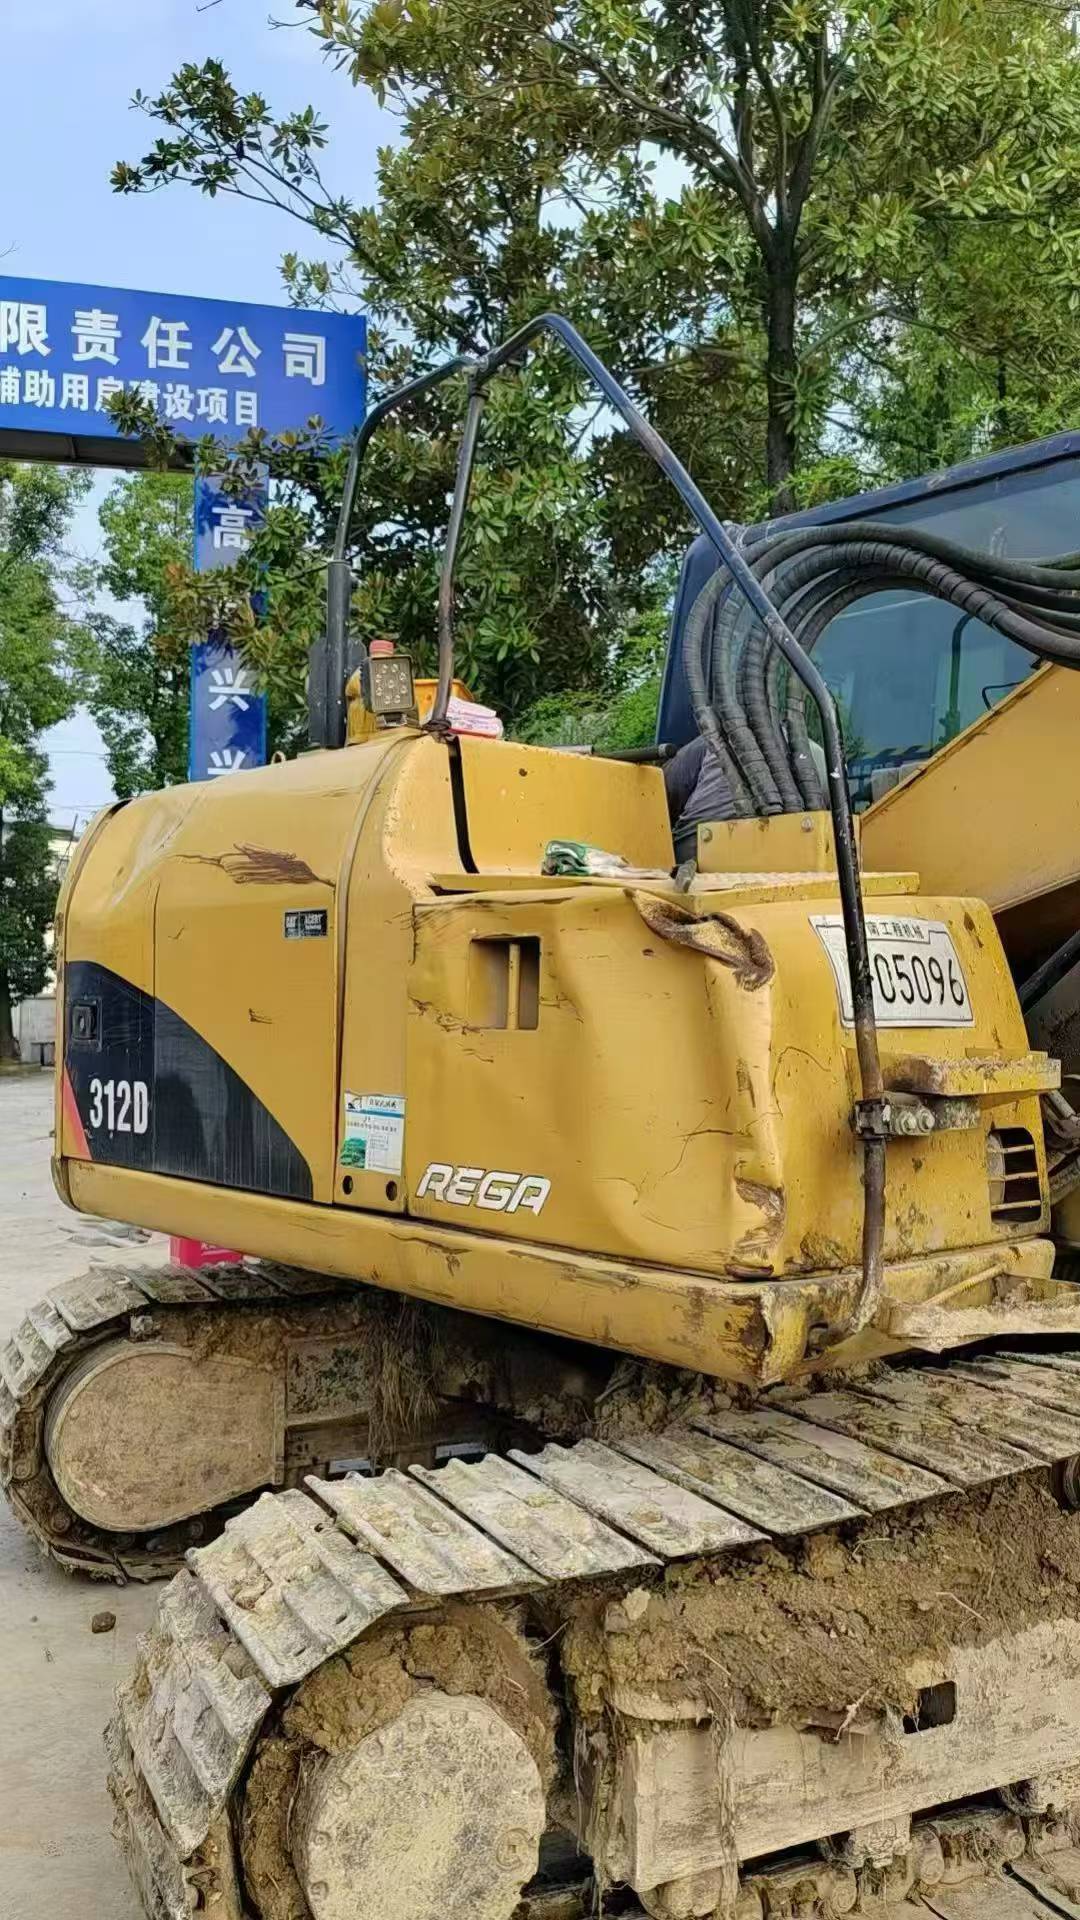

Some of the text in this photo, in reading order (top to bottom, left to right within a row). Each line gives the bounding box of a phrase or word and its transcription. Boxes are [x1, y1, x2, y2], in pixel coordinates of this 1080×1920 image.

[0, 301, 327, 386] 限责任公司
[873, 953, 964, 1006] 05096
[89, 1077, 149, 1134] 312D
[415, 1162, 552, 1217] REGA
